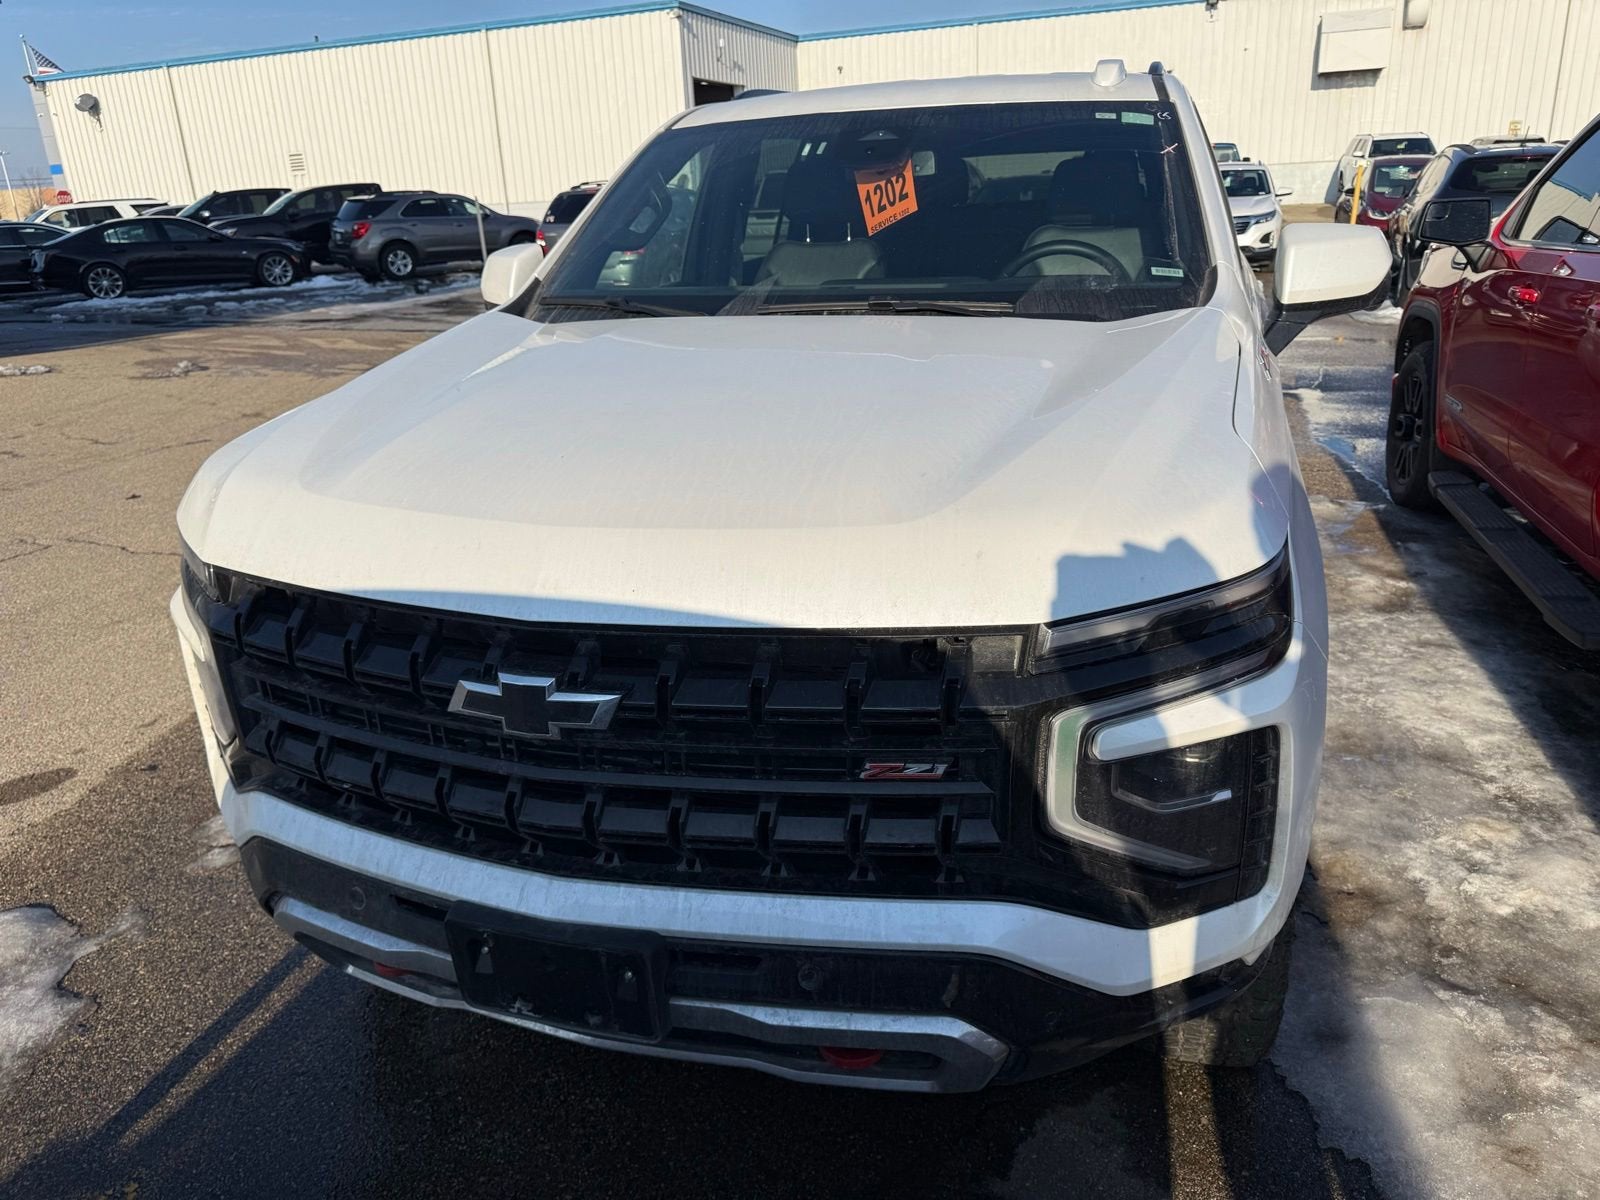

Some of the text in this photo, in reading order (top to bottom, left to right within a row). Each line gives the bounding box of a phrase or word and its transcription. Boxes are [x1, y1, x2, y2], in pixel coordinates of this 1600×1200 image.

[57, 194, 72, 203] STOP
[865, 173, 909, 218] 1202
[871, 207, 910, 233] SERVICE 1202
[860, 763, 948, 779] Z71
